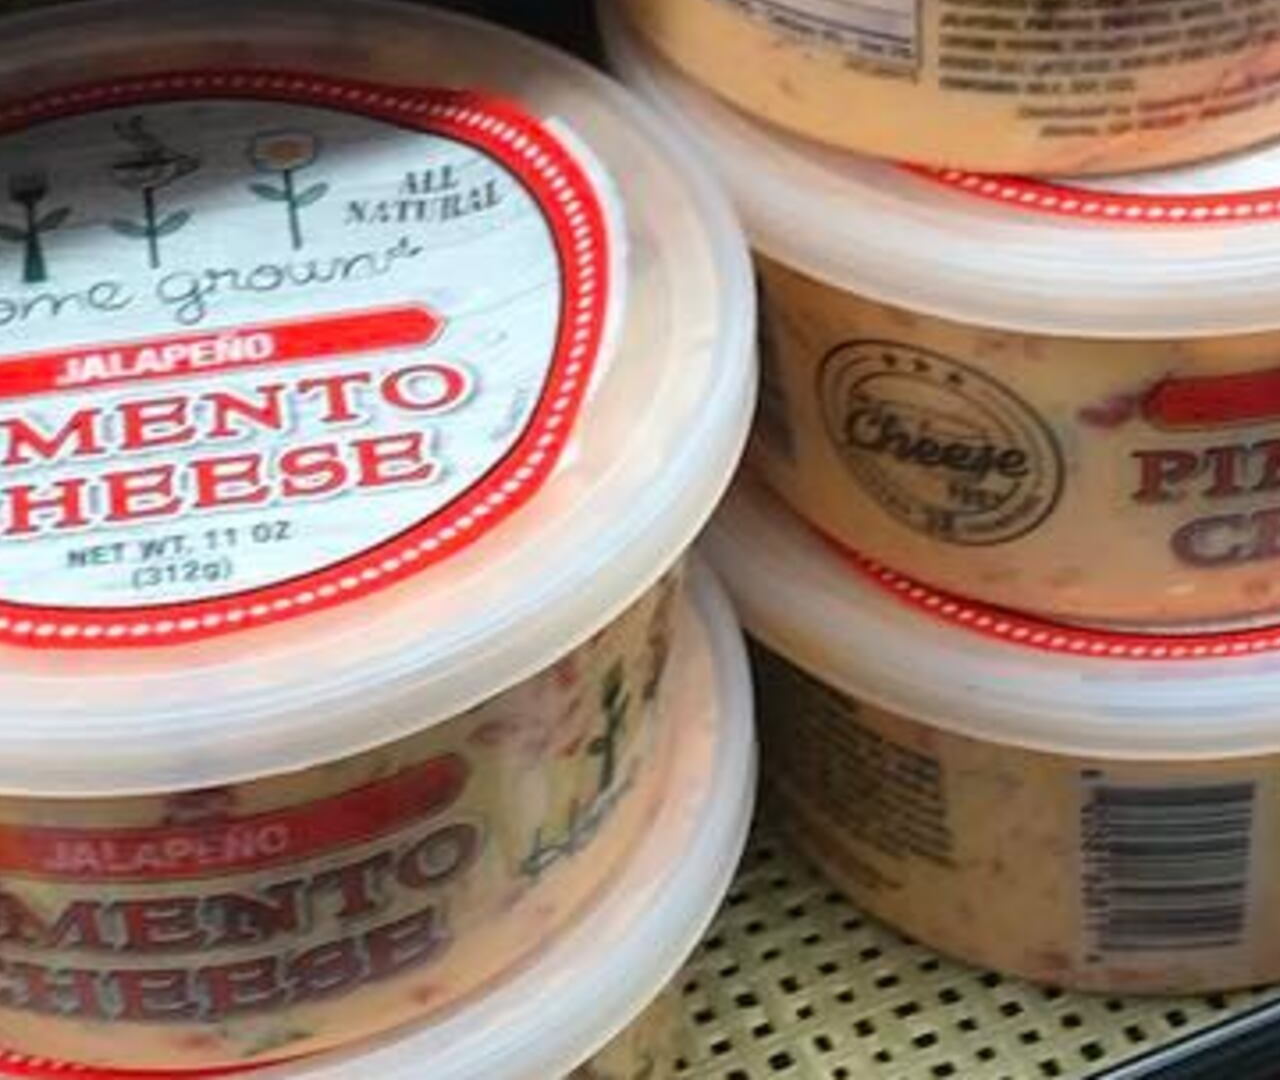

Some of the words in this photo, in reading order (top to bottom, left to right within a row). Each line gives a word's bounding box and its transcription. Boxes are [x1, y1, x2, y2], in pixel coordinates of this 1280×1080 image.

[344, 178, 504, 225] NATURAL
[399, 165, 460, 194] ALL
[55, 333, 276, 387] JALAPEÑO
[846, 406, 1029, 482] Cheese
[67, 541, 125, 570] NET
[139, 533, 195, 561] WT.
[206, 528, 238, 551] 11
[252, 520, 292, 546] OZ
[132, 558, 233, 591] (312g)
[45, 823, 293, 874] JALAPEÑO
